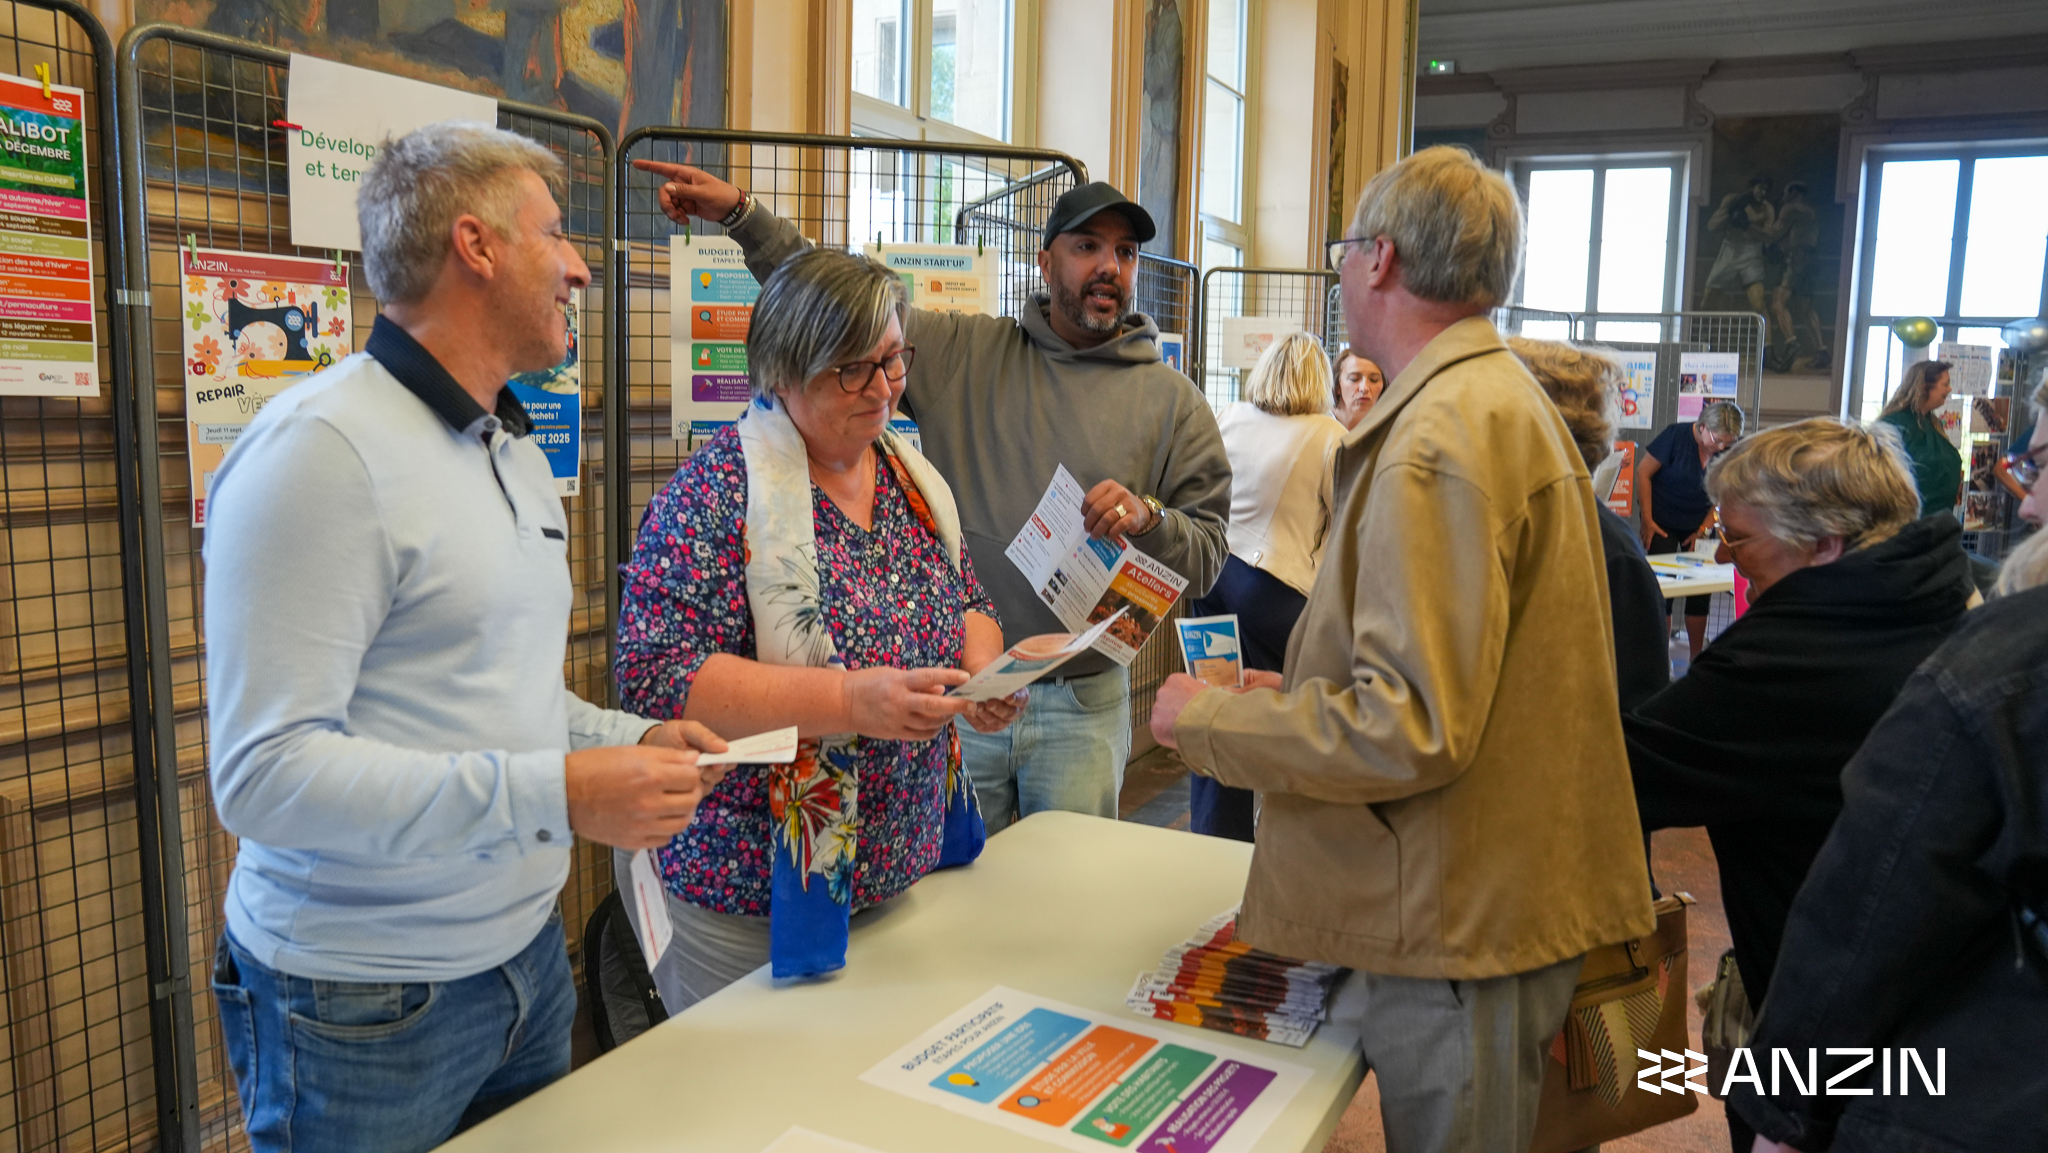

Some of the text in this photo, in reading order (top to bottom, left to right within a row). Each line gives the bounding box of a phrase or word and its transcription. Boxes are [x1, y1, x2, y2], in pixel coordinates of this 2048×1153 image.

[4, 140, 71, 160] DÉCEMBRE
[306, 160, 326, 178] et
[44, 176, 68, 185] CAPEP
[698, 248, 734, 256] BUDGET
[14, 258, 28, 266] des
[30, 260, 44, 268] sols
[712, 256, 736, 264] ÉTAPES
[894, 256, 964, 268] ANZIN START'UP
[716, 272, 750, 280] PROPOSER
[8, 288, 33, 296] octobre
[2, 322, 13, 330] les
[196, 384, 246, 404] REPAIR
[531, 402, 547, 412] pour
[548, 402, 562, 410] une
[206, 427, 222, 435] Jeudi
[548, 432, 570, 444] 2025
[1146, 562, 1182, 588] ANZIN
[1127, 567, 1172, 599] Ateliers
[901, 1042, 947, 1069] BUDGET
